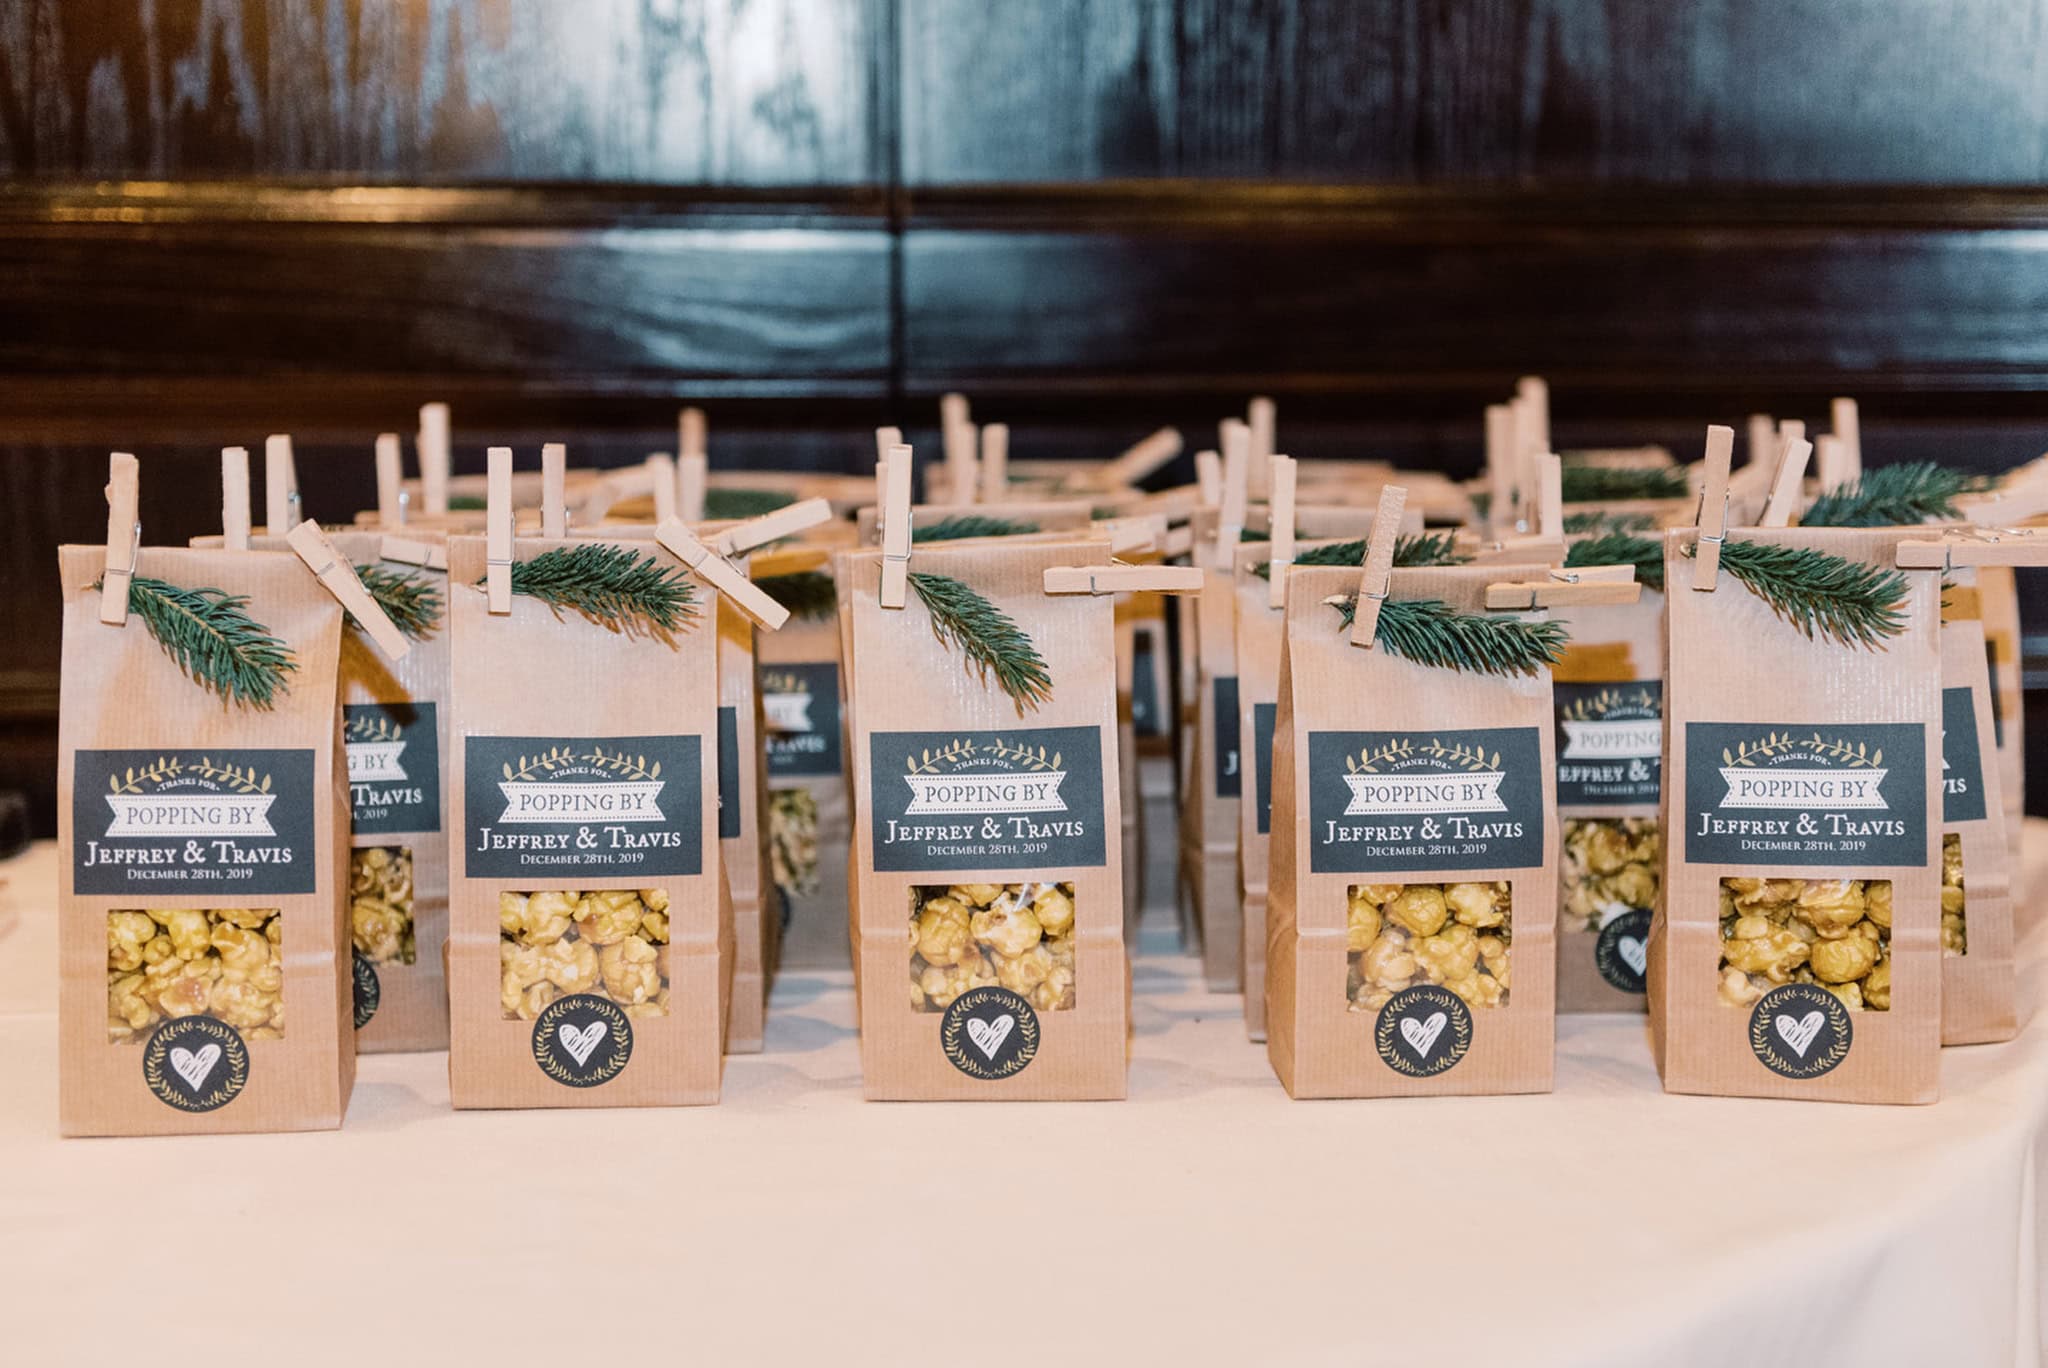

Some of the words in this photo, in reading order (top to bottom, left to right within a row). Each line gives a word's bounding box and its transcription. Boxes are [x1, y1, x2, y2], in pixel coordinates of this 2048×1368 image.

[365, 754, 387, 770] BY
[956, 758, 990, 771] THANKS
[993, 758, 1010, 770] FOR
[1394, 758, 1428, 771] THANKS
[1430, 759, 1447, 769] FOR
[1772, 752, 1807, 764] THANKS
[1810, 754, 1828, 764] FOR
[553, 767, 588, 779] THANKS
[590, 768, 608, 778] FOR
[1559, 765, 1624, 782] EFFREY
[1628, 759, 1650, 782] &
[160, 778, 195, 791] THANKS
[198, 778, 216, 790] FOR
[925, 786, 1016, 802] POPPING
[1022, 784, 1049, 800] BY
[1364, 784, 1455, 803] POPPING
[1461, 784, 1488, 801] BY
[1740, 780, 1834, 798] POPPING
[1840, 780, 1868, 798] BY
[350, 784, 423, 806] TRAVIS
[520, 794, 613, 811] POPPING
[620, 793, 646, 810] BY
[126, 807, 221, 825] POPPING
[230, 806, 256, 824] BY
[1697, 812, 1789, 836] JEFFREY
[1796, 812, 1818, 835] &
[1824, 814, 1905, 836] TRAVIS
[478, 828, 570, 852] JEFFREY
[576, 826, 598, 849] &
[604, 826, 681, 848] TRAVIS
[884, 820, 974, 844] JEFFREY
[981, 817, 1002, 840] &
[1008, 816, 1084, 839] TRAVIS
[1324, 820, 1414, 844] JEFFREY
[1420, 817, 1442, 840] &
[1448, 816, 1523, 839] TRAVIS
[84, 841, 176, 866] JEFFREY
[183, 840, 206, 864] &
[211, 840, 292, 864] TRAVIS
[927, 845, 985, 856] DECEMBER
[1023, 842, 1048, 854] 2019
[1366, 846, 1426, 857] DECEMBER
[1462, 844, 1487, 854] 2019
[1741, 840, 1800, 850] DECEMBER
[1840, 840, 1866, 850] 2019
[520, 854, 580, 864] DECEMBER
[618, 852, 644, 864] 2019
[127, 869, 188, 880] DECEMBER
[226, 868, 253, 880] 2019
